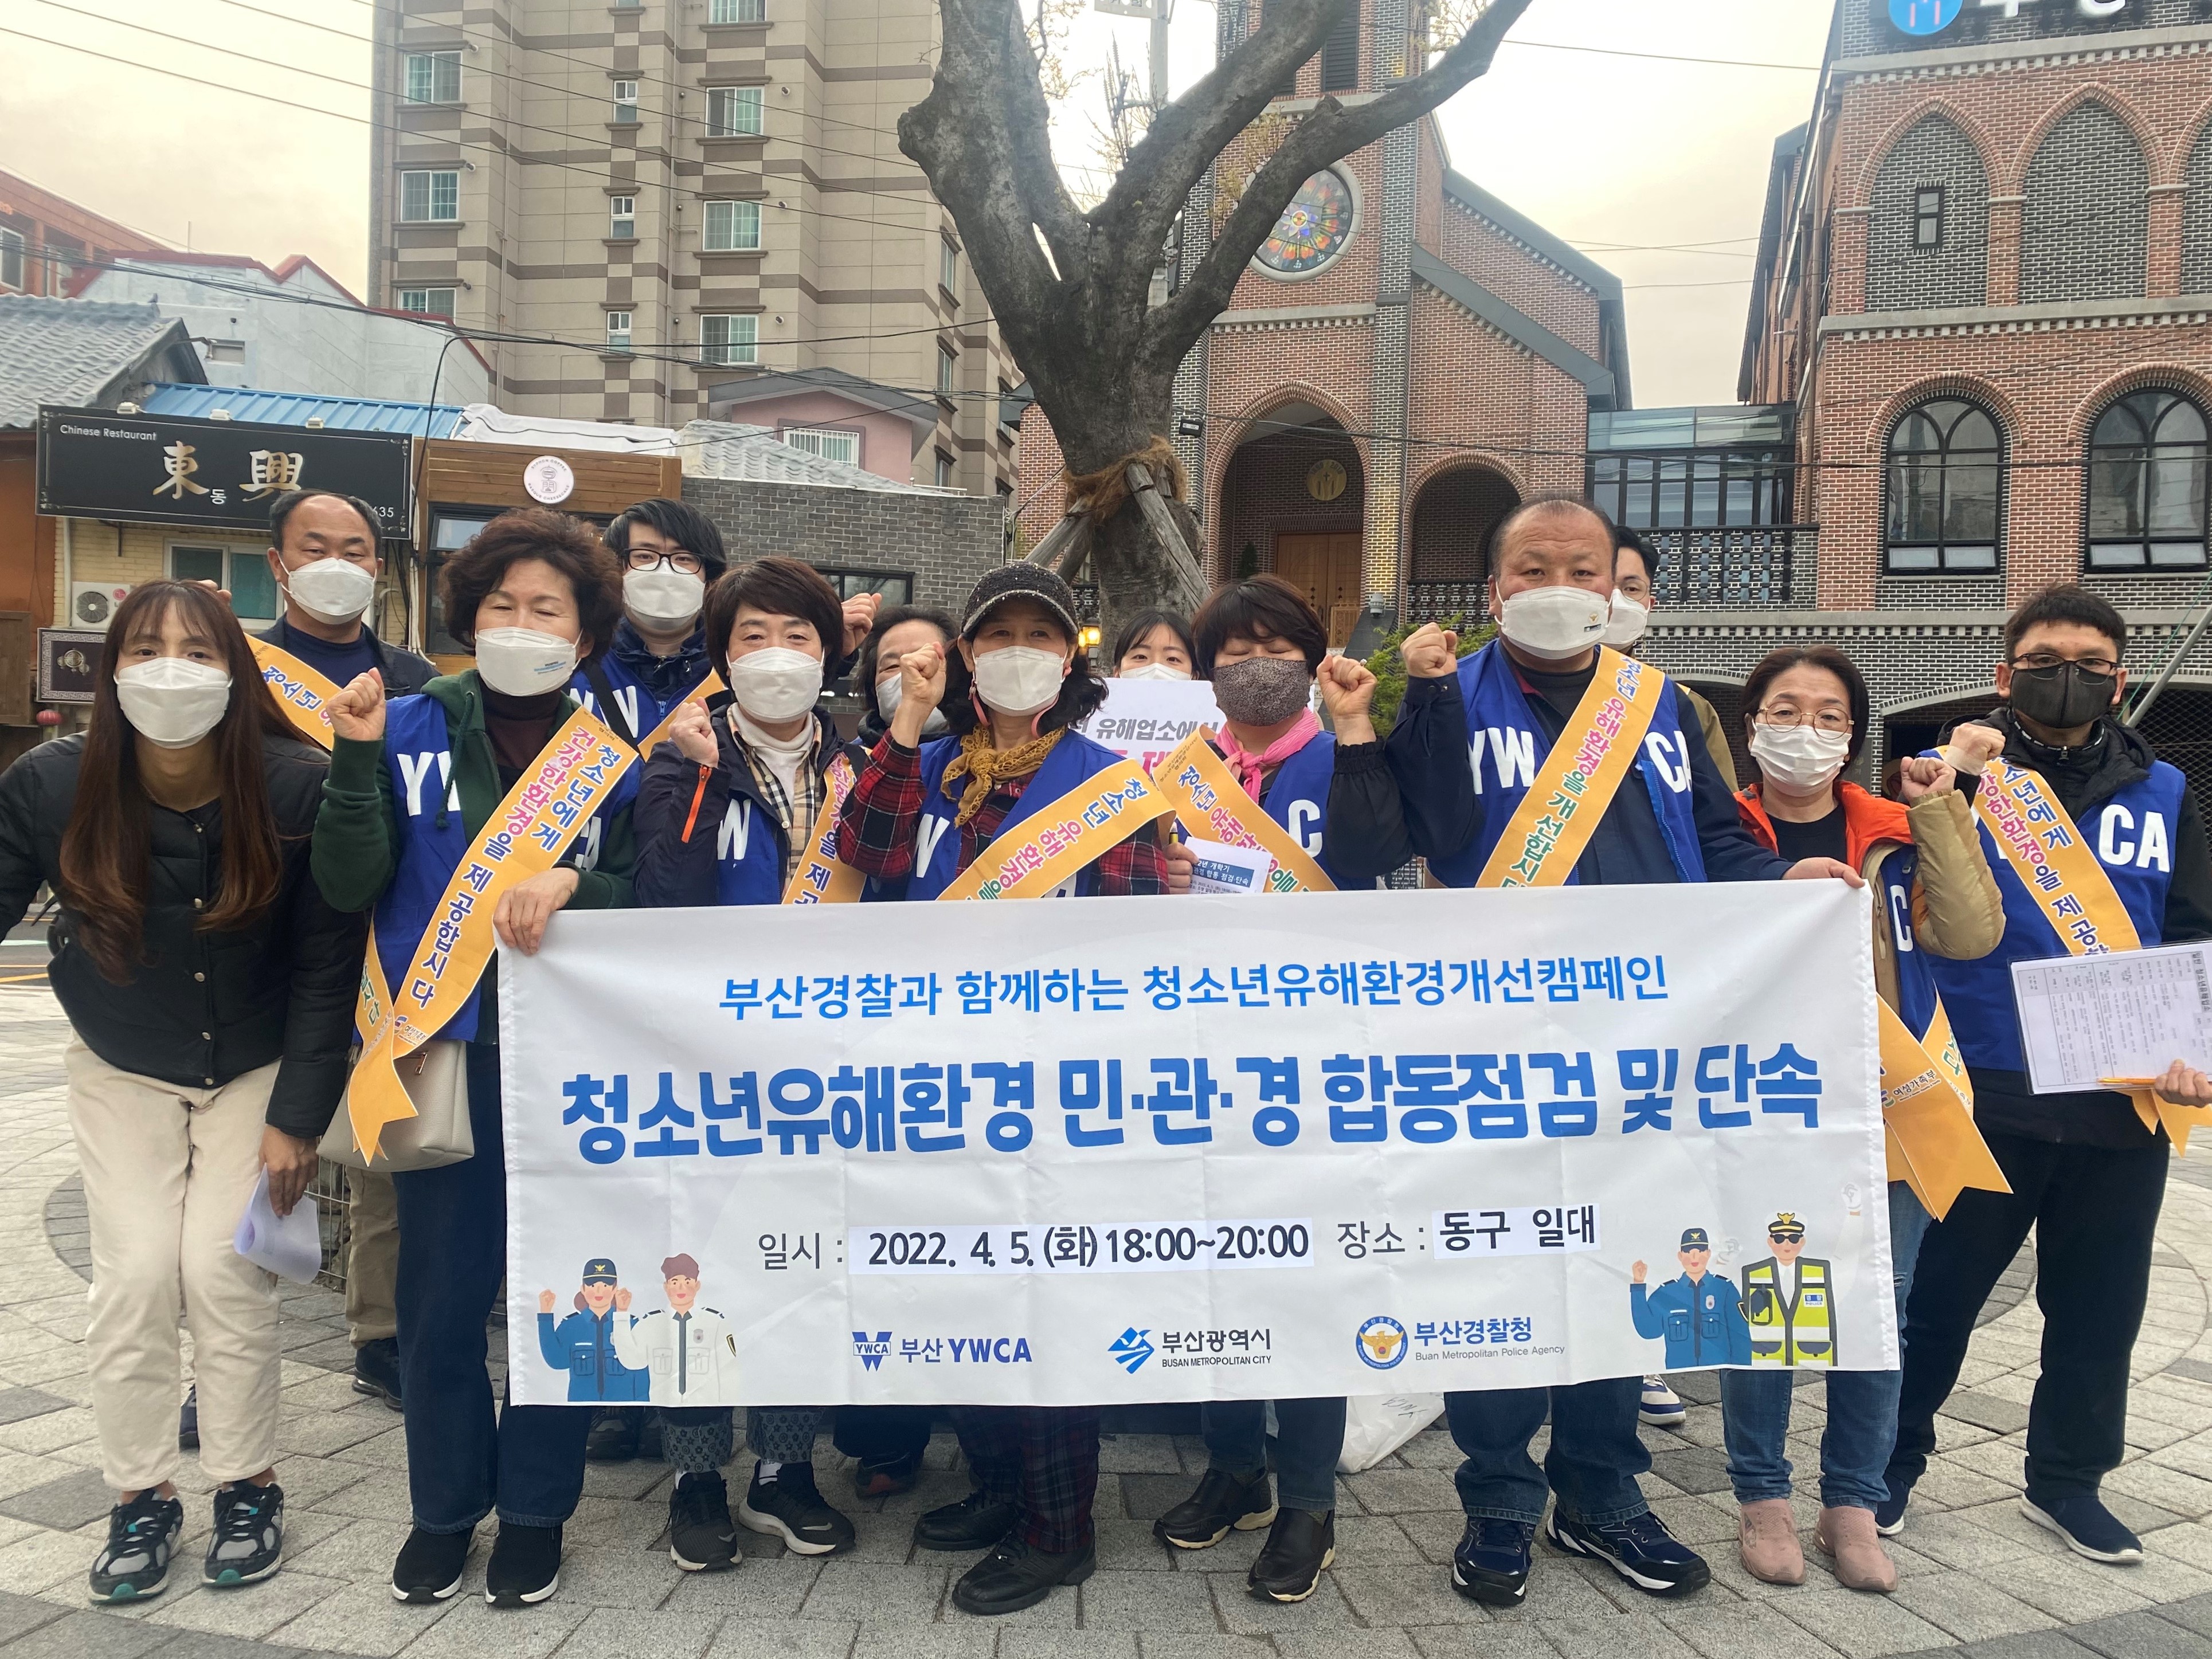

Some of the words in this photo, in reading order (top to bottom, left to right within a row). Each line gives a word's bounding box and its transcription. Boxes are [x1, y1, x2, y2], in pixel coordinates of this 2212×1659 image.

[60, 425, 100, 436] Chinese
[104, 428, 156, 441] Restaurant
[210, 489, 226, 504] 동
[1082, 778, 1148, 828] 청소년
[1179, 764, 1218, 811] 청소년
[1287, 799, 1323, 858] C
[2098, 804, 2170, 873] CA
[1890, 884, 1913, 953] C
[718, 971, 942, 1021] 부산경찰과
[955, 967, 1129, 1015] 함께하는
[1143, 955, 1669, 1011] 청소년유해환경개선캠페인
[1893, 1070, 1936, 1096] 여성가족부
[562, 1061, 1034, 1164] 청소년유해환경
[1058, 1057, 1301, 1147] 민·관·경
[1321, 1052, 1598, 1144] 합동점검
[1616, 1048, 1679, 1134] 및
[1693, 1042, 1823, 1129] 단속
[758, 1232, 821, 1270] 일시
[868, 1231, 956, 1268] 2022.
[969, 1231, 996, 1268] 4.
[1105, 1224, 1309, 1264] 18:00~20:00
[1337, 1221, 1406, 1260] 장소
[1439, 1211, 1511, 1251] 동구
[1532, 1205, 1595, 1248] 일대
[1162, 1328, 1271, 1354] 부산광역시
[1414, 1316, 1532, 1347] 부산경찰청
[855, 1343, 889, 1355] YWCA
[899, 1338, 943, 1363] 부산
[947, 1338, 1033, 1363] YWCA
[1162, 1358, 1189, 1368] BUSAN
[1191, 1356, 1251, 1366] METROPOLITAN
[1252, 1355, 1271, 1365] CITY
[1415, 1351, 1439, 1361] Buan
[1442, 1349, 1498, 1360] Metropolitan
[1501, 1347, 1529, 1357] Police
[1531, 1344, 1565, 1356] Agency
